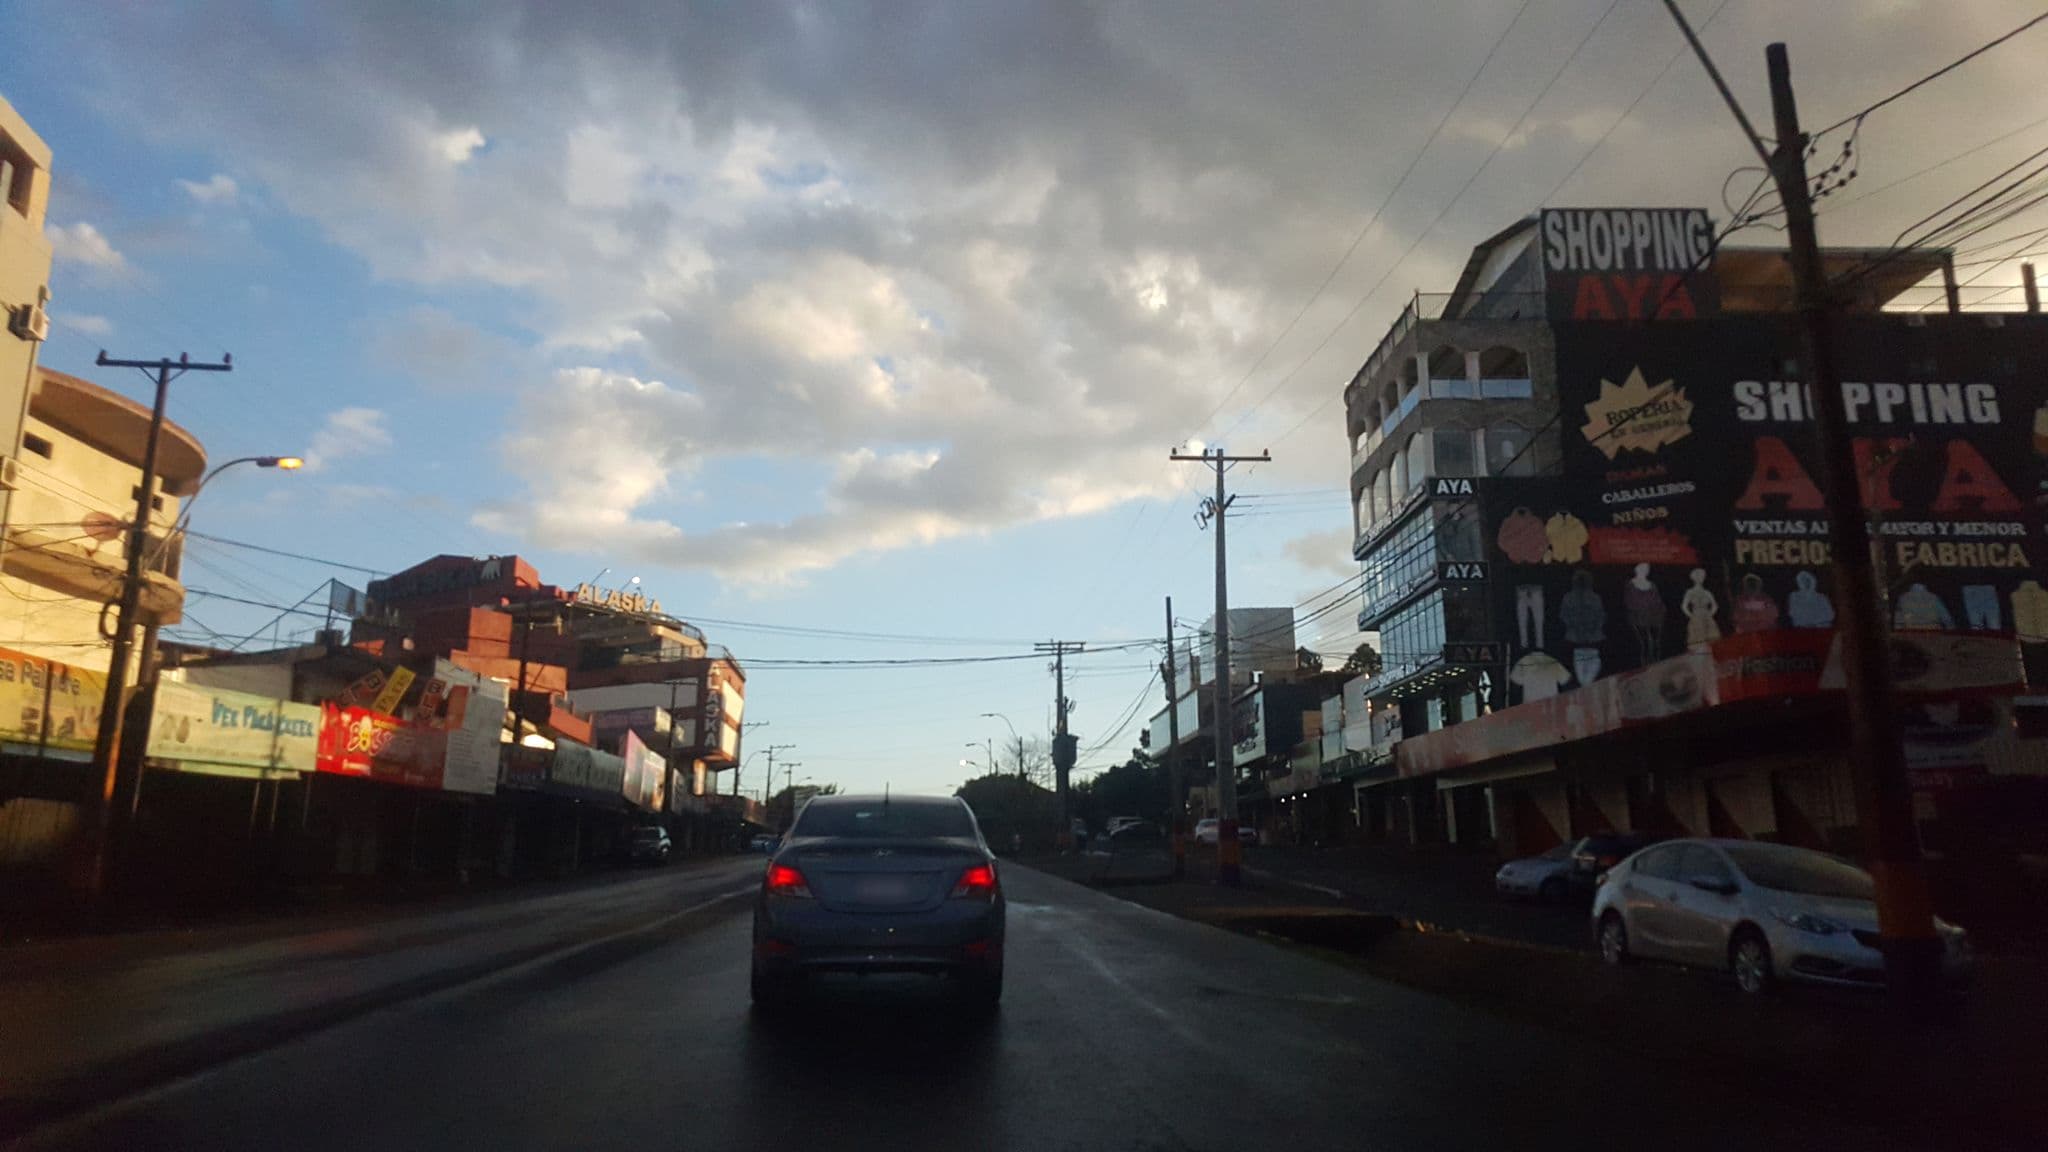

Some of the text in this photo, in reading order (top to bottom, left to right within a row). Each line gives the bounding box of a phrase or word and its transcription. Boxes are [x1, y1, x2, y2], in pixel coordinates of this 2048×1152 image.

[1544, 209, 1711, 271] SHOPPING
[1572, 273, 1697, 321] AYA
[1733, 380, 2001, 424] SHPPING
[1436, 478, 1473, 495] AYA
[1733, 434, 2024, 514] AYA
[1602, 481, 1696, 504] CABALLEROS
[1733, 519, 1807, 535] VENTAS
[1936, 521, 1951, 537] Y
[1952, 521, 2028, 537] MENOR
[1896, 541, 2031, 569] FABRICA
[1446, 563, 1484, 580] AYA
[577, 582, 663, 614] ALASKA
[703, 662, 721, 748] ALASKA
